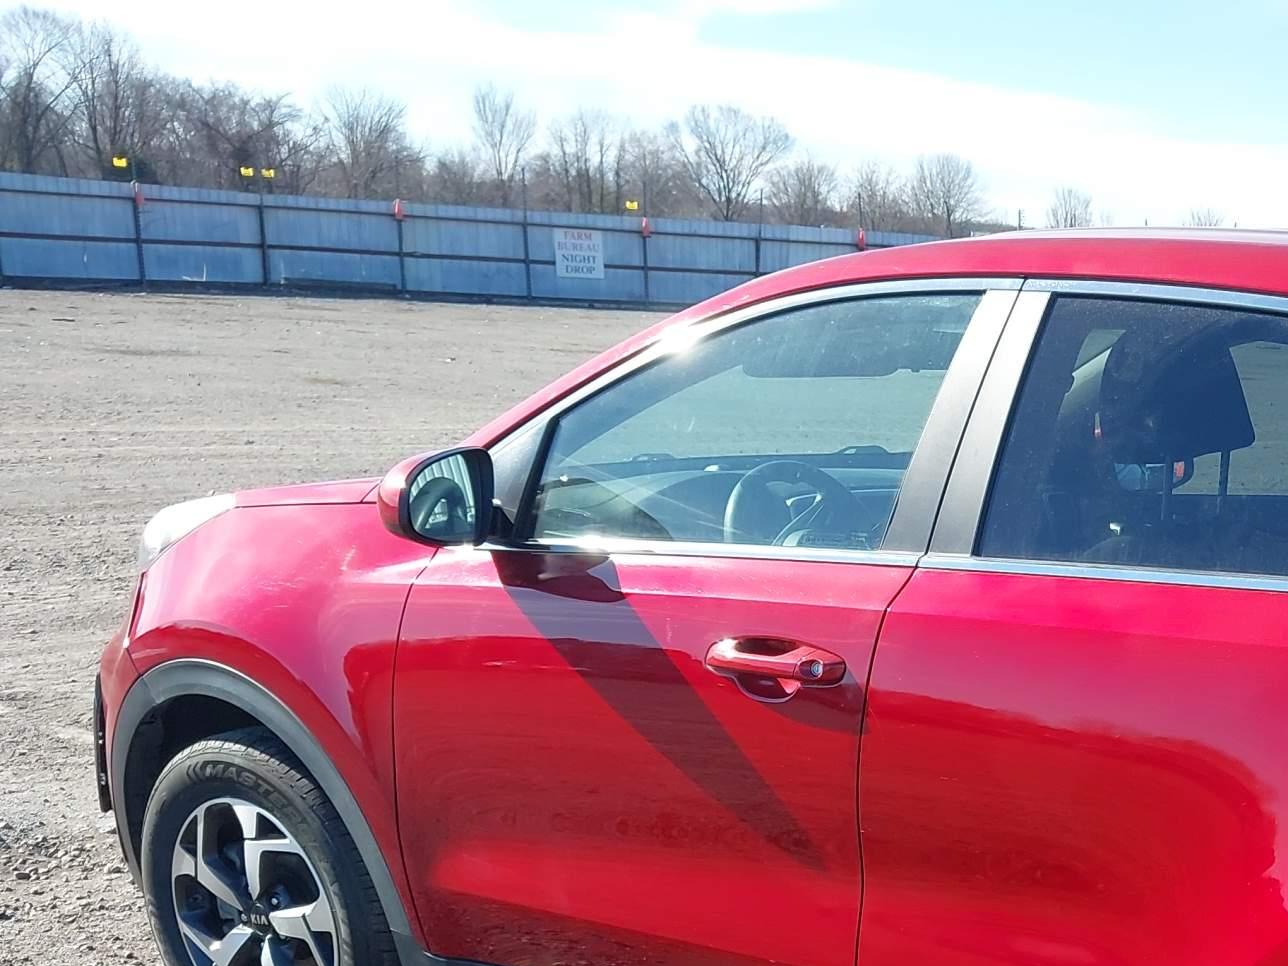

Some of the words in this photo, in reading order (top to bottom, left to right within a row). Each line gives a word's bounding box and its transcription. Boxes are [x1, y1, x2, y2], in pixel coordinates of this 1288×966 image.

[563, 231, 593, 241] FARM
[557, 241, 600, 253] BUREAU
[561, 254, 596, 265] NIGHT
[565, 264, 596, 275] DROP
[250, 914, 269, 925] KIA
